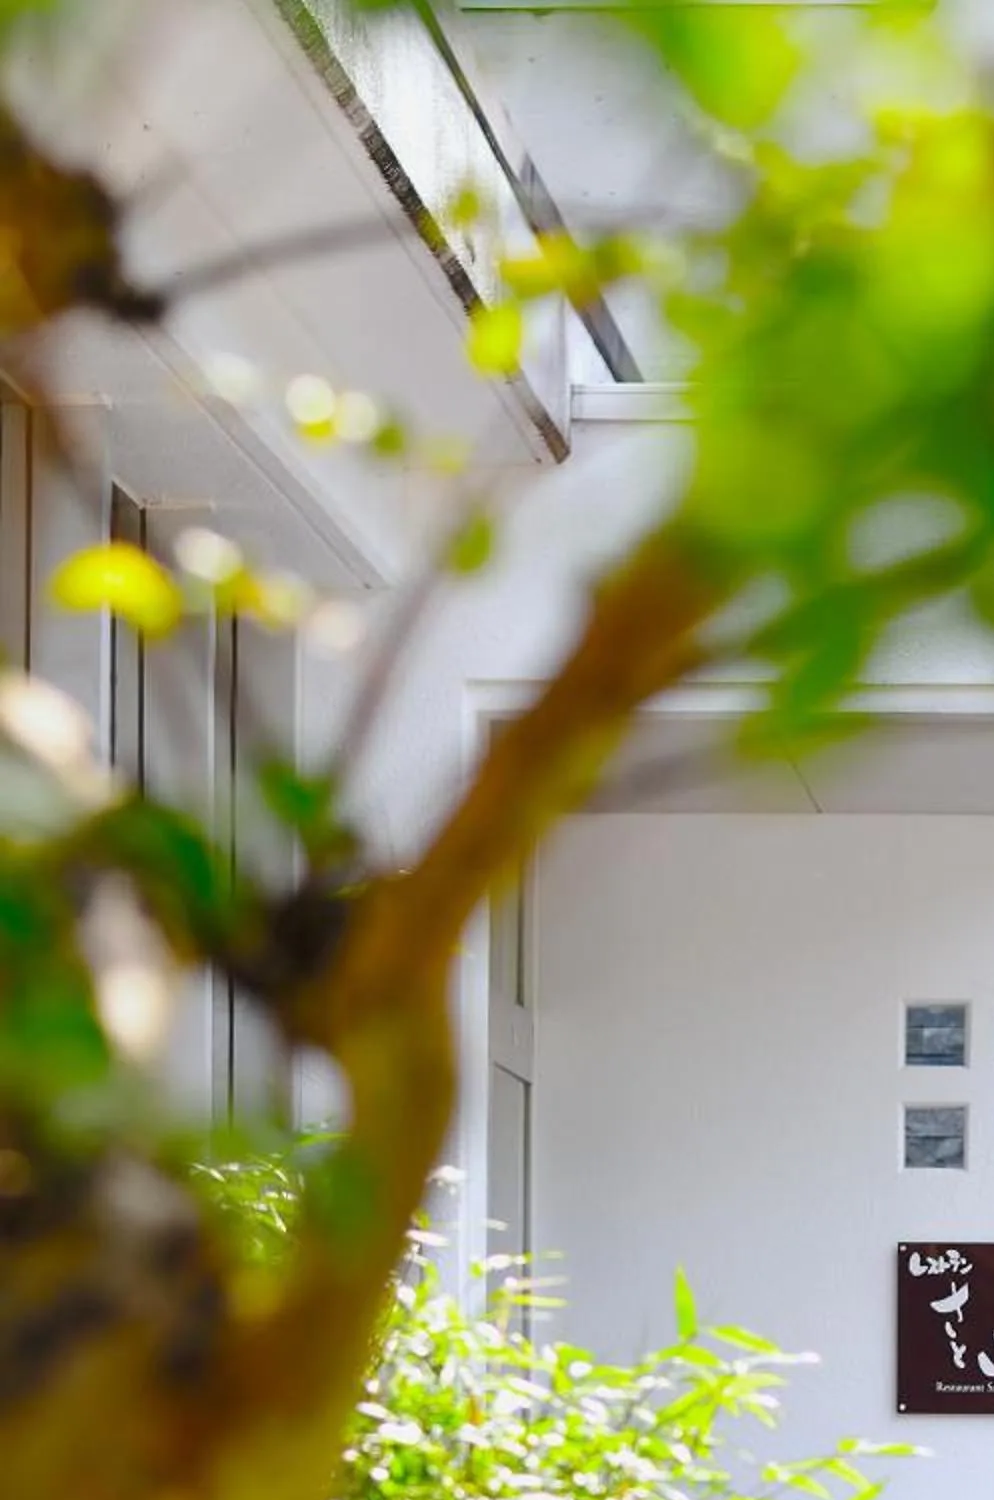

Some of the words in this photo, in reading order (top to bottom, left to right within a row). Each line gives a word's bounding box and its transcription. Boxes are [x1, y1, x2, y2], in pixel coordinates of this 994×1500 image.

[908, 1249, 973, 1277] レストラン
[936, 1381, 985, 1393] Restaurant
